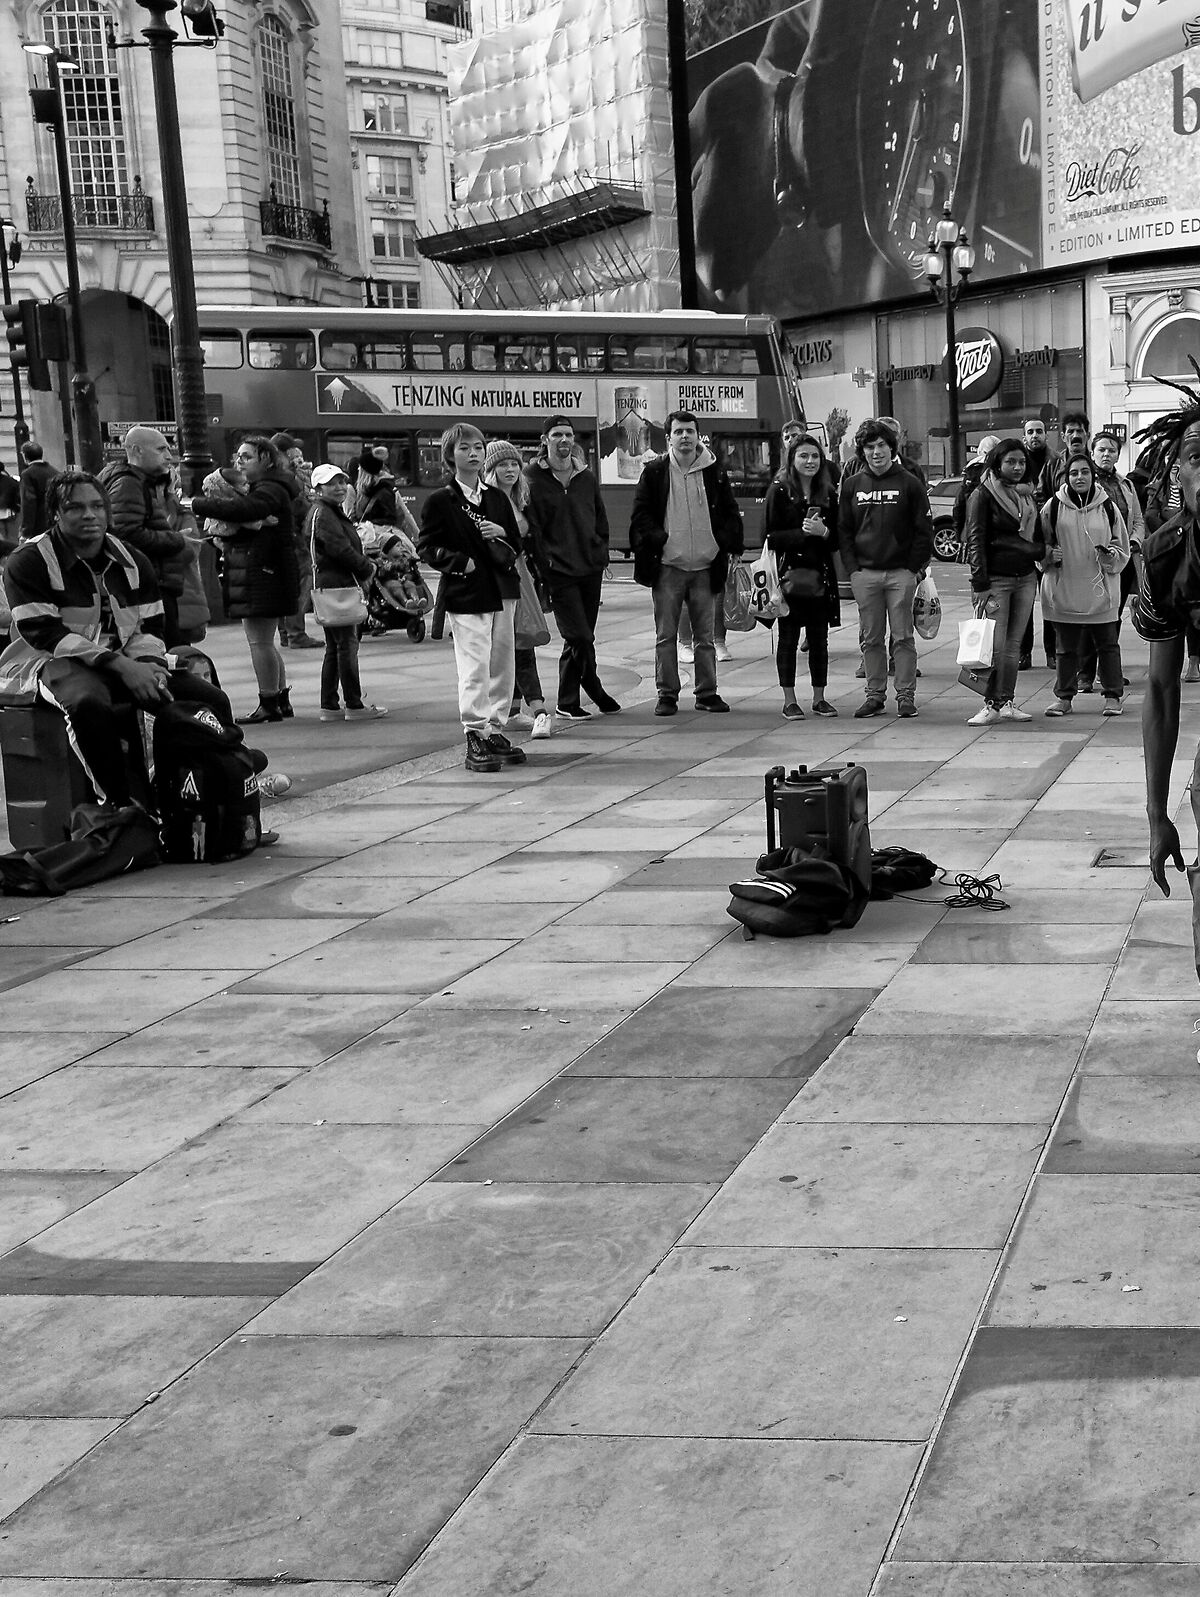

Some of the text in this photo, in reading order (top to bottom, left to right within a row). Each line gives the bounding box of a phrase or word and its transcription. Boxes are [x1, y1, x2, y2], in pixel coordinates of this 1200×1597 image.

[1044, 24, 1054, 108] EDITION
[1047, 132, 1056, 215] LIMITED
[1065, 162, 1099, 202] Diet
[115, 240, 153, 251] LIFE
[1059, 232, 1104, 254] EDITION
[1117, 221, 1174, 243] LIMITED
[954, 338, 993, 390] Boots
[1014, 345, 1057, 368] beauty
[884, 364, 934, 387] pharmacy
[391, 385, 583, 409] TENZING NATURAL ENERGY
[678, 385, 744, 399] PURELY FROM
[616, 398, 648, 410] TENZING
[679, 399, 748, 413] PLANTS. NICE.
[856, 490, 900, 501] MIT
